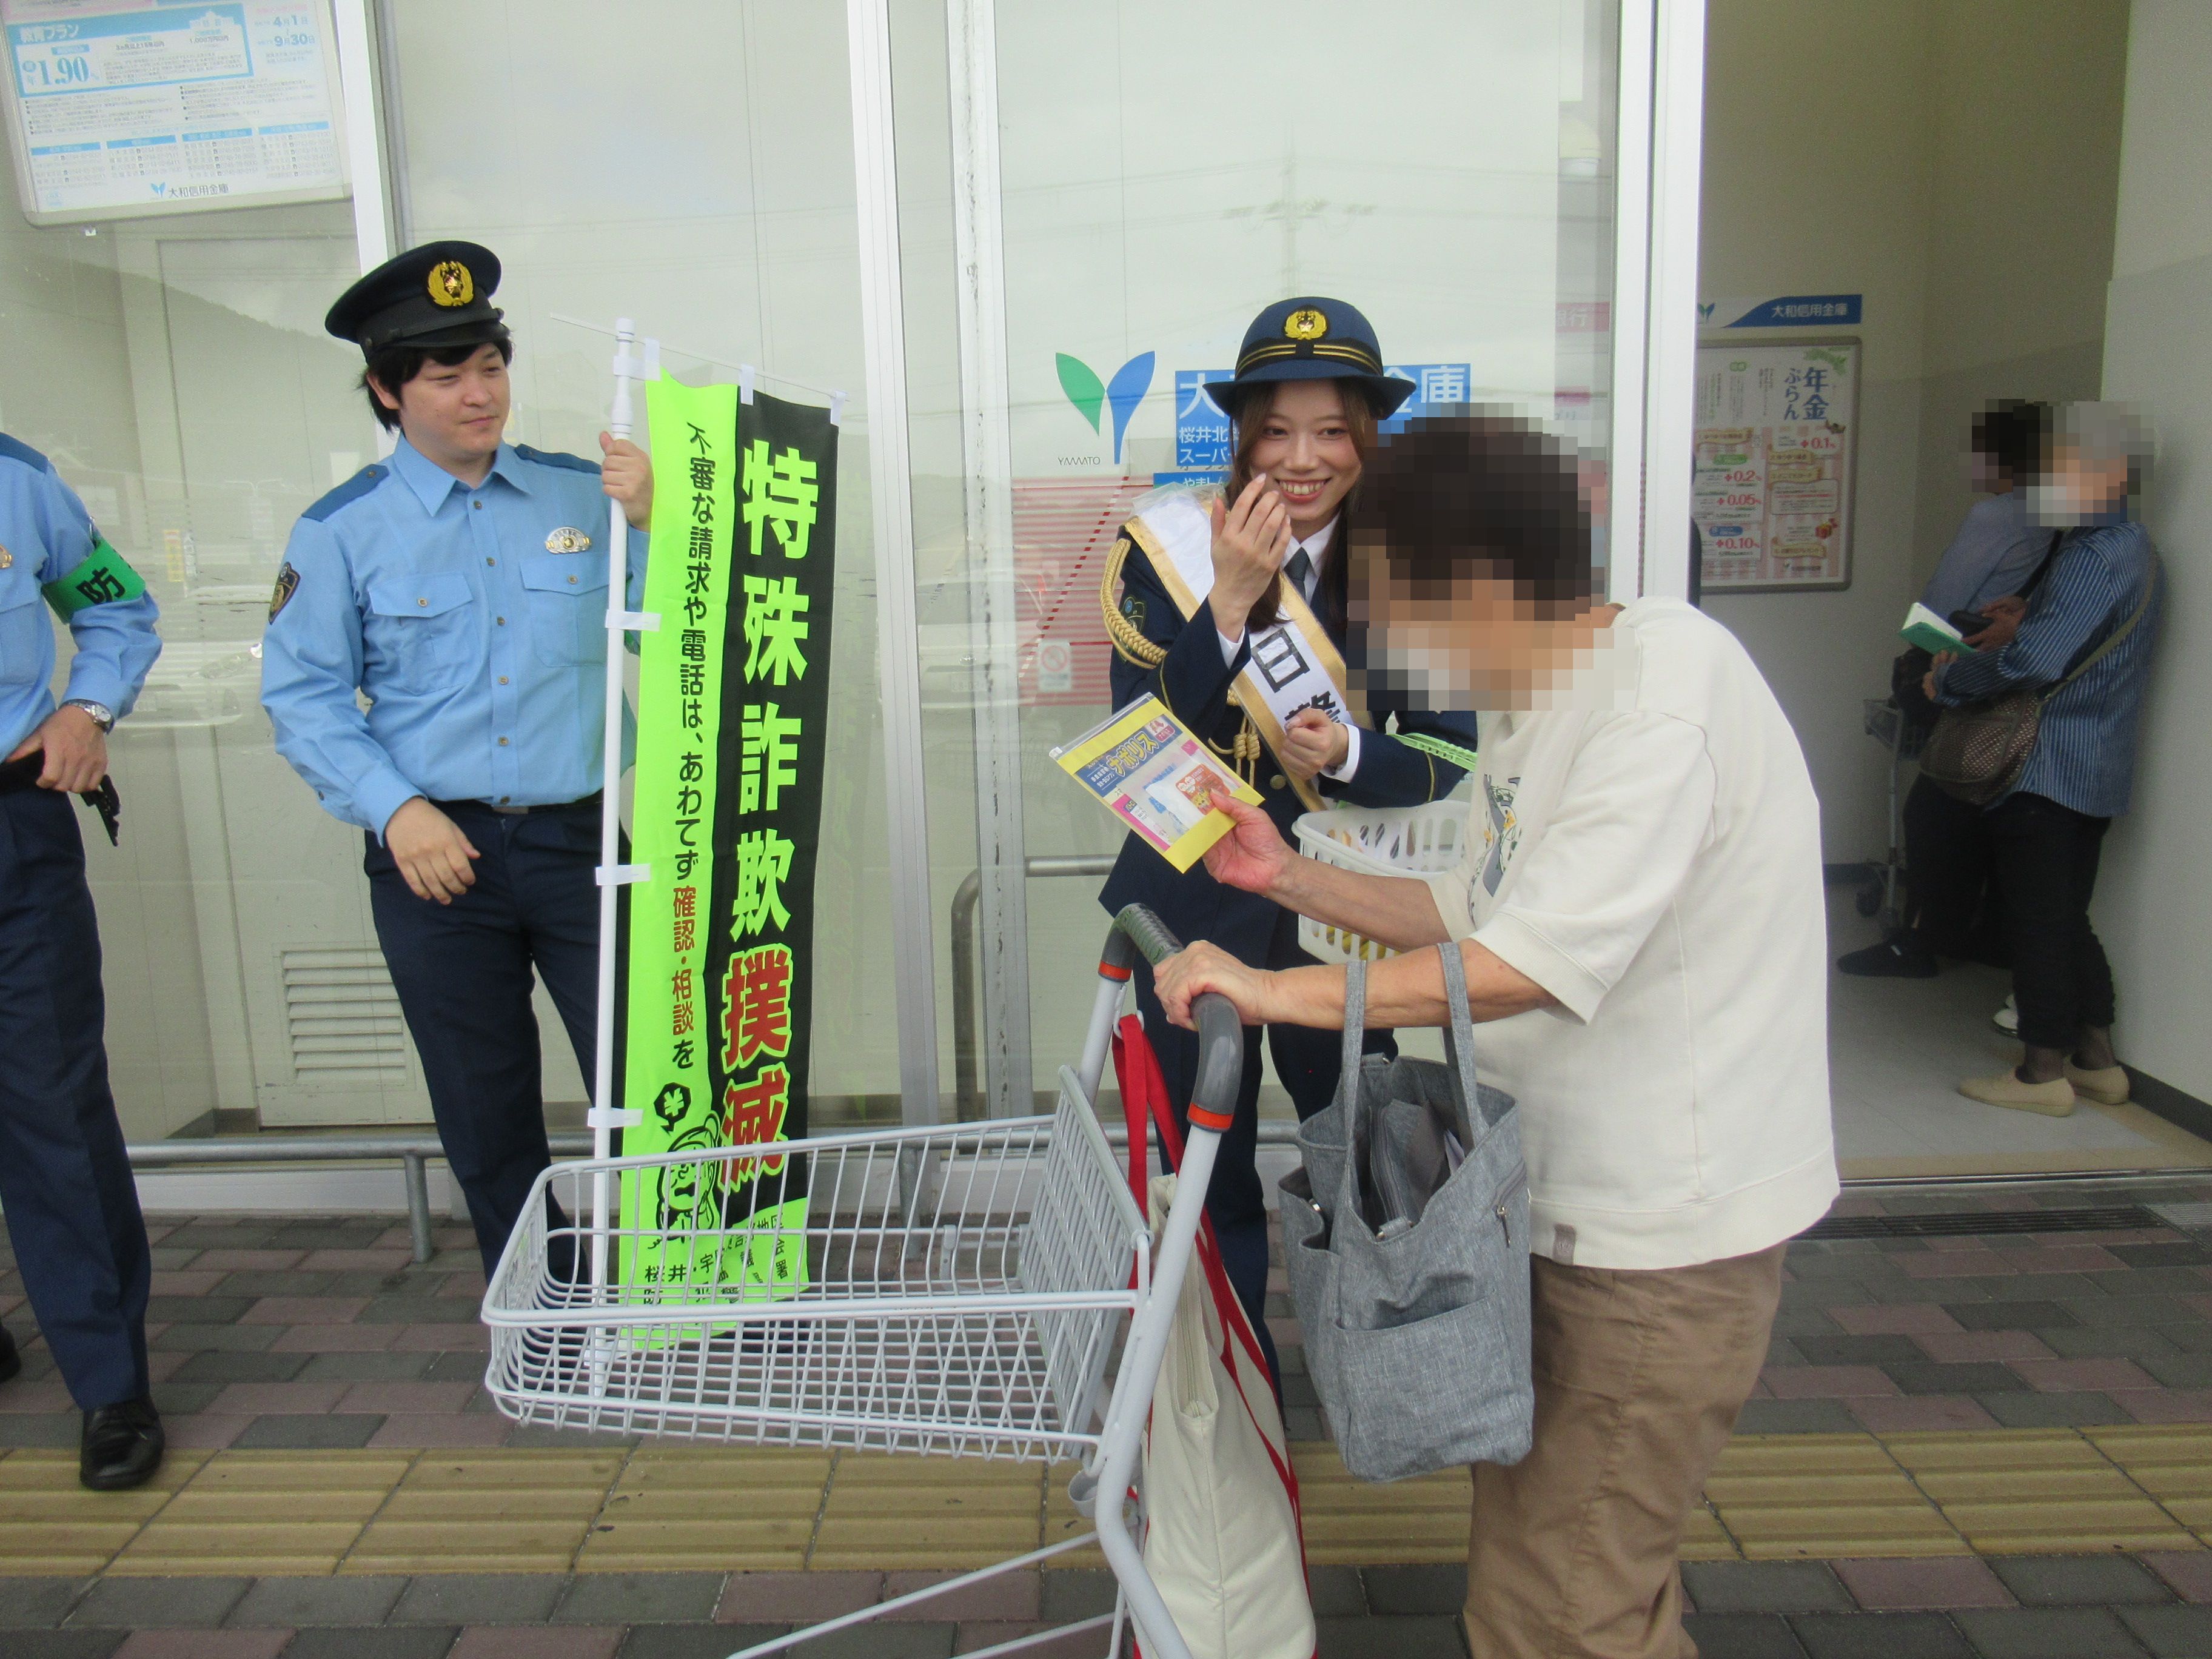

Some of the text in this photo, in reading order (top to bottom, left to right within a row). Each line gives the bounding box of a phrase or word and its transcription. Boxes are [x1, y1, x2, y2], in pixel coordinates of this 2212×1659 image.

[169, 184, 229, 197] 大和信用金庫
[1772, 303, 1847, 318] 大和信用金庫
[1803, 367, 1829, 420] 年金
[1179, 426, 1239, 443] 桜井北
[1057, 457, 1101, 466] YAMATO
[720, 438, 819, 1192] 特殊詐欺撲滅
